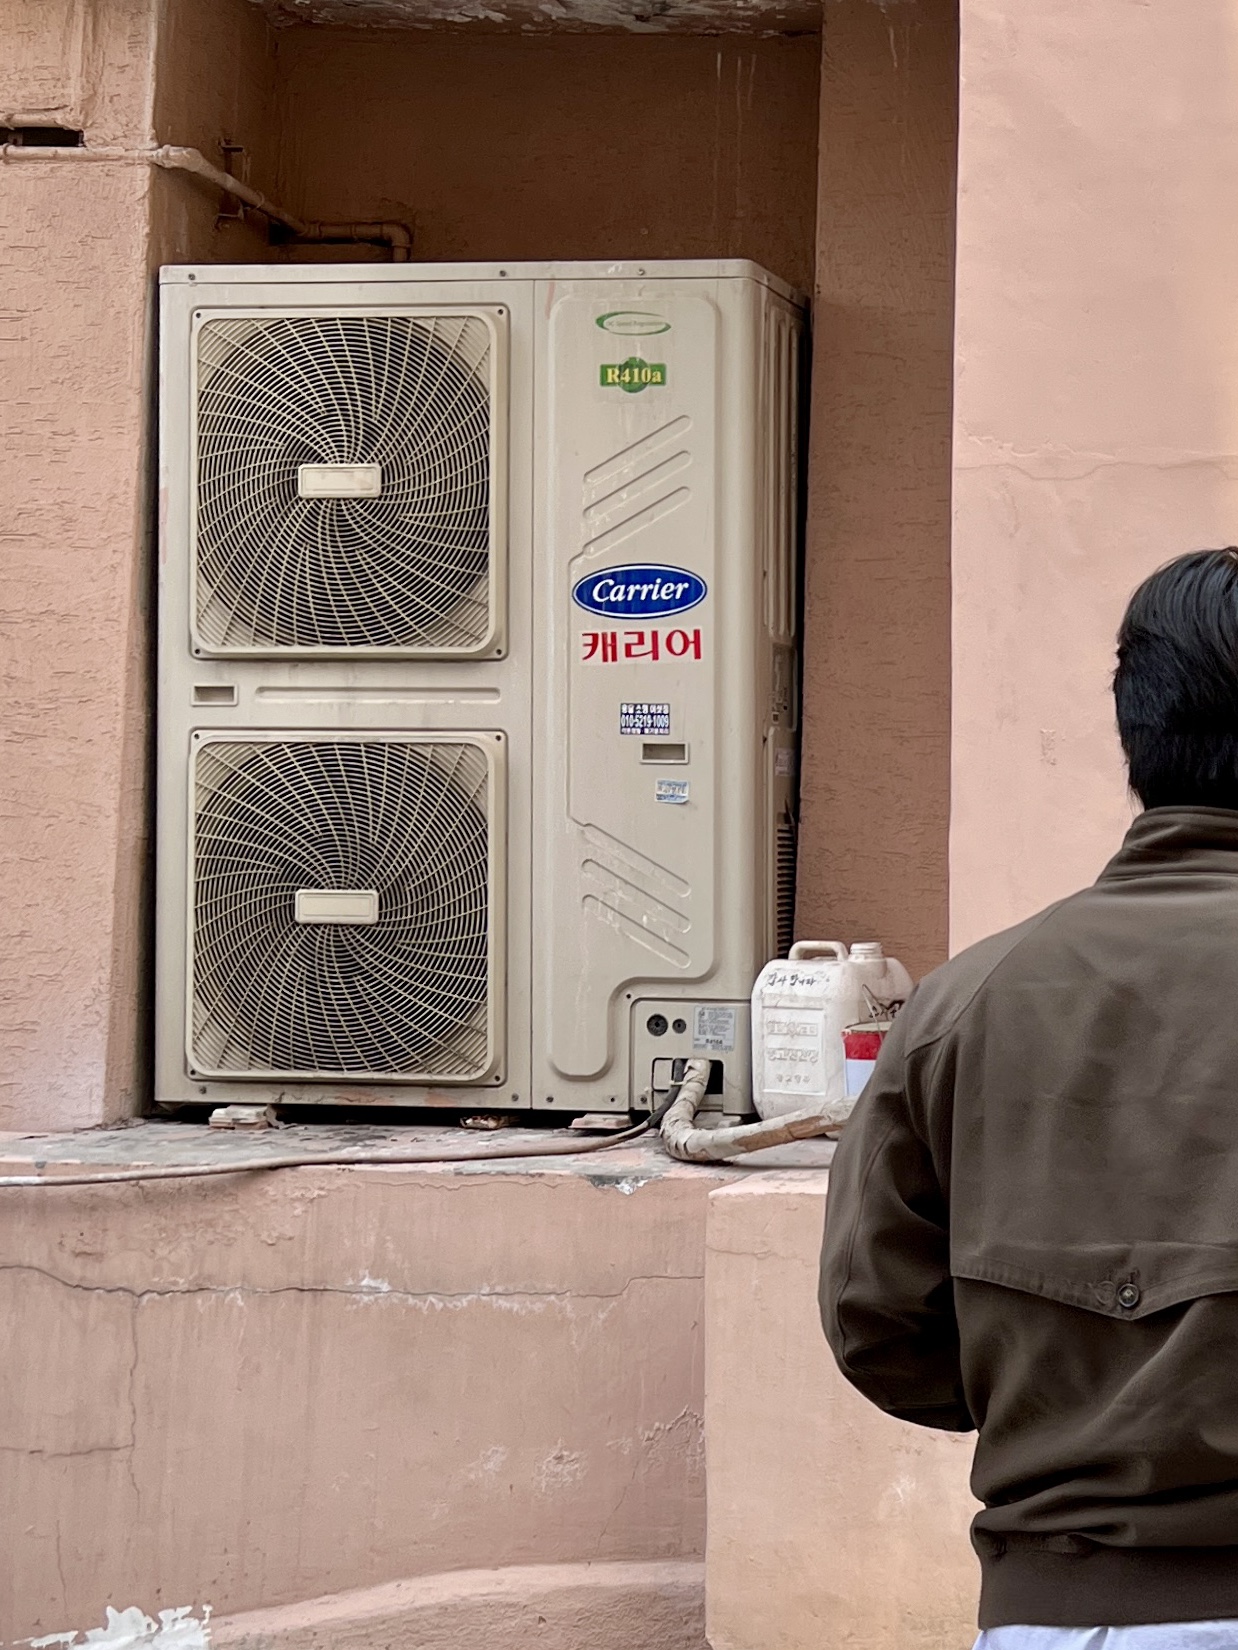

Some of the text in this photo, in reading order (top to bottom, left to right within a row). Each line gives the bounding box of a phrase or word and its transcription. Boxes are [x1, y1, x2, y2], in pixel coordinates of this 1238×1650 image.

[606, 367, 663, 384] R410a
[592, 577, 690, 603] Carrier
[581, 628, 702, 663] 캐리어
